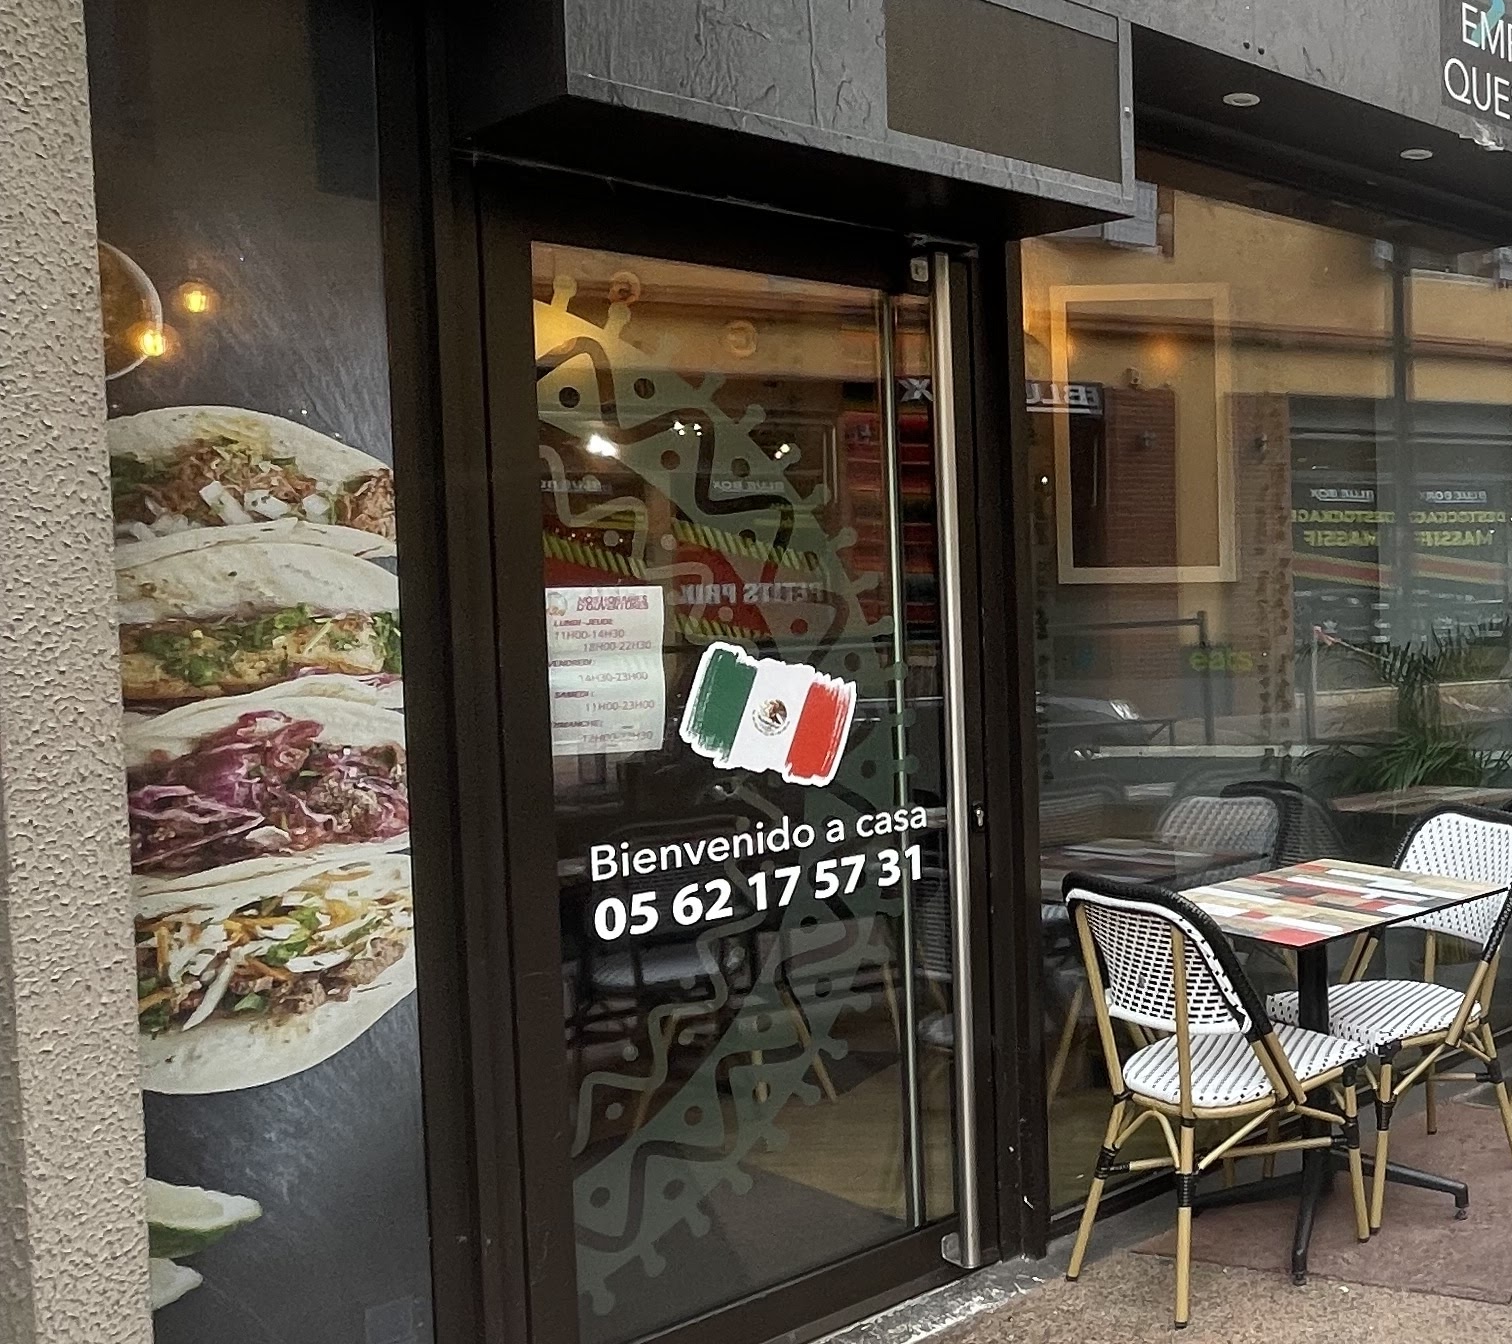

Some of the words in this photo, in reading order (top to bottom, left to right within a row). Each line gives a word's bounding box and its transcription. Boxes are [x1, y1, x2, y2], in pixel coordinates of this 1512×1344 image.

[590, 815, 815, 882] Bienvenido
[825, 818, 845, 843] a
[855, 806, 928, 838] casa
[594, 890, 659, 941] 05
[672, 878, 734, 926] 62
[748, 865, 801, 912] 17
[814, 854, 867, 899] 57
[877, 844, 923, 887] 31
